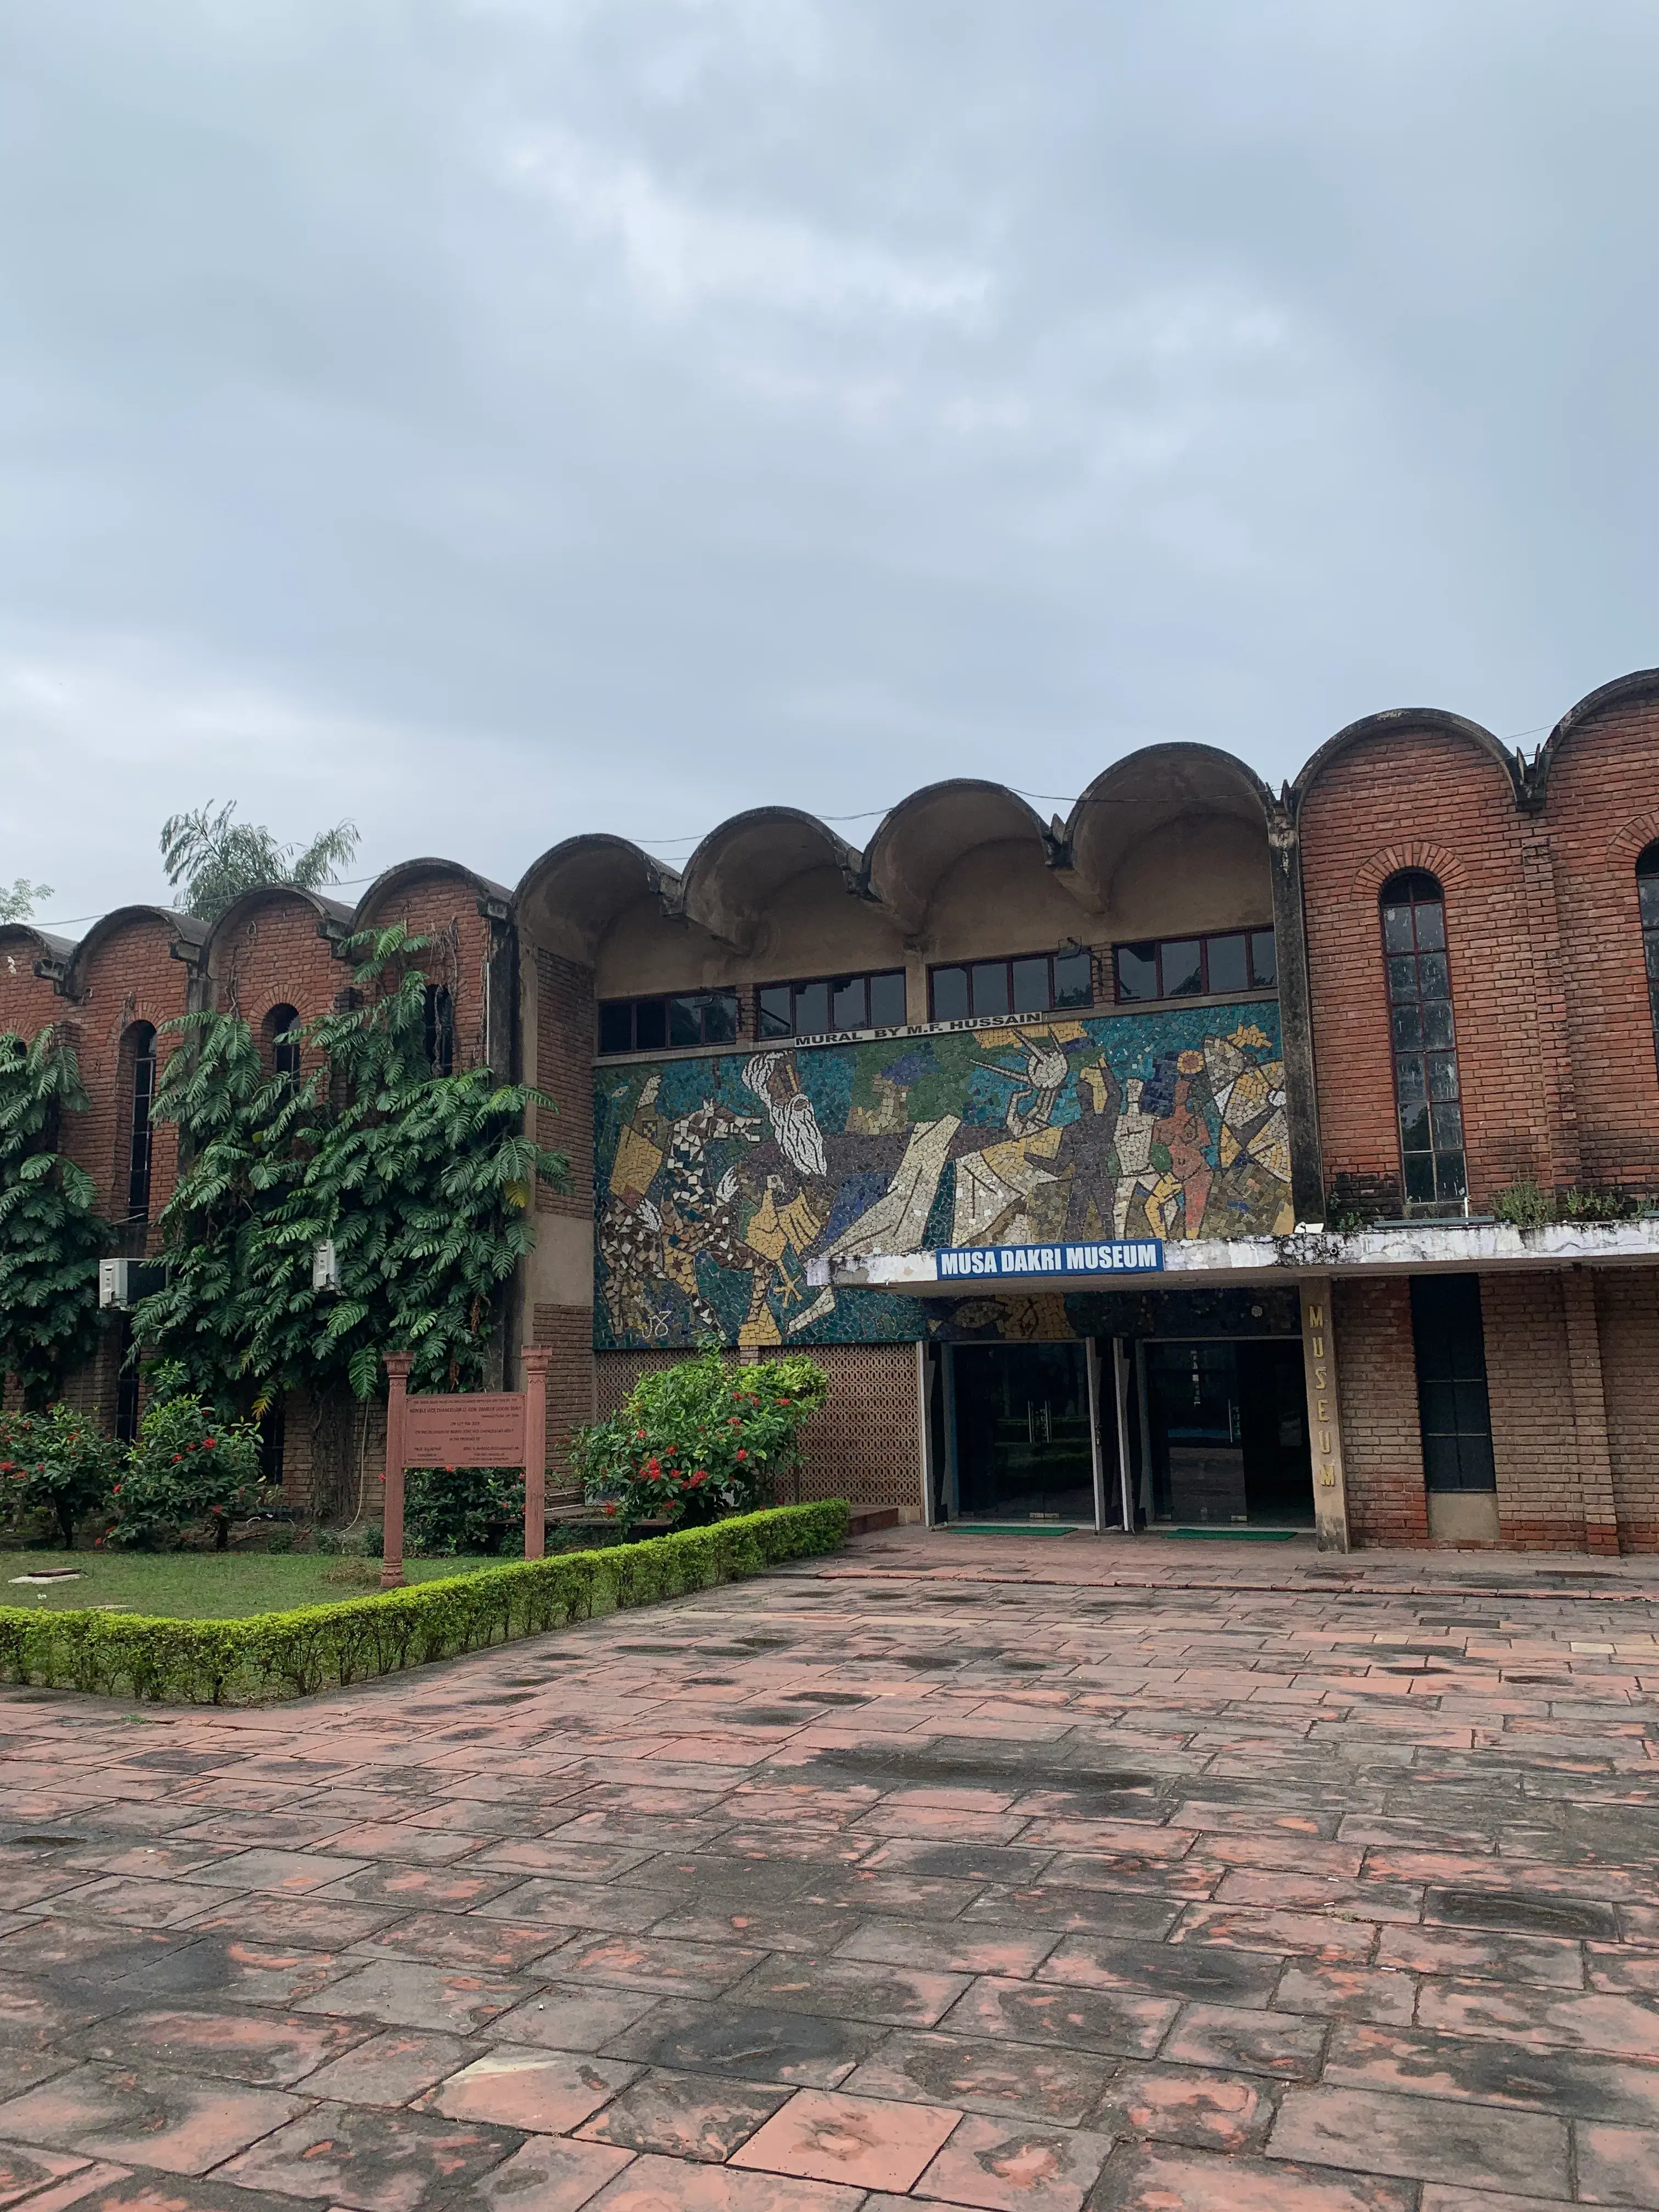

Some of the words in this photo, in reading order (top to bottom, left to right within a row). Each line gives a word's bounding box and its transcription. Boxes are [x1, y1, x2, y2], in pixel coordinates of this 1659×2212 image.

[795, 1031, 864, 1046] MURAL
[874, 1028, 901, 1037] BY
[906, 1024, 944, 1035] M.F.
[950, 1013, 1041, 1030] HUSSAIN
[941, 1251, 997, 1276] MUSA
[1001, 1248, 1062, 1272] DAKRI
[1066, 1244, 1157, 1270] MUSEUM
[1309, 1306, 1335, 1486] MUSEUM
